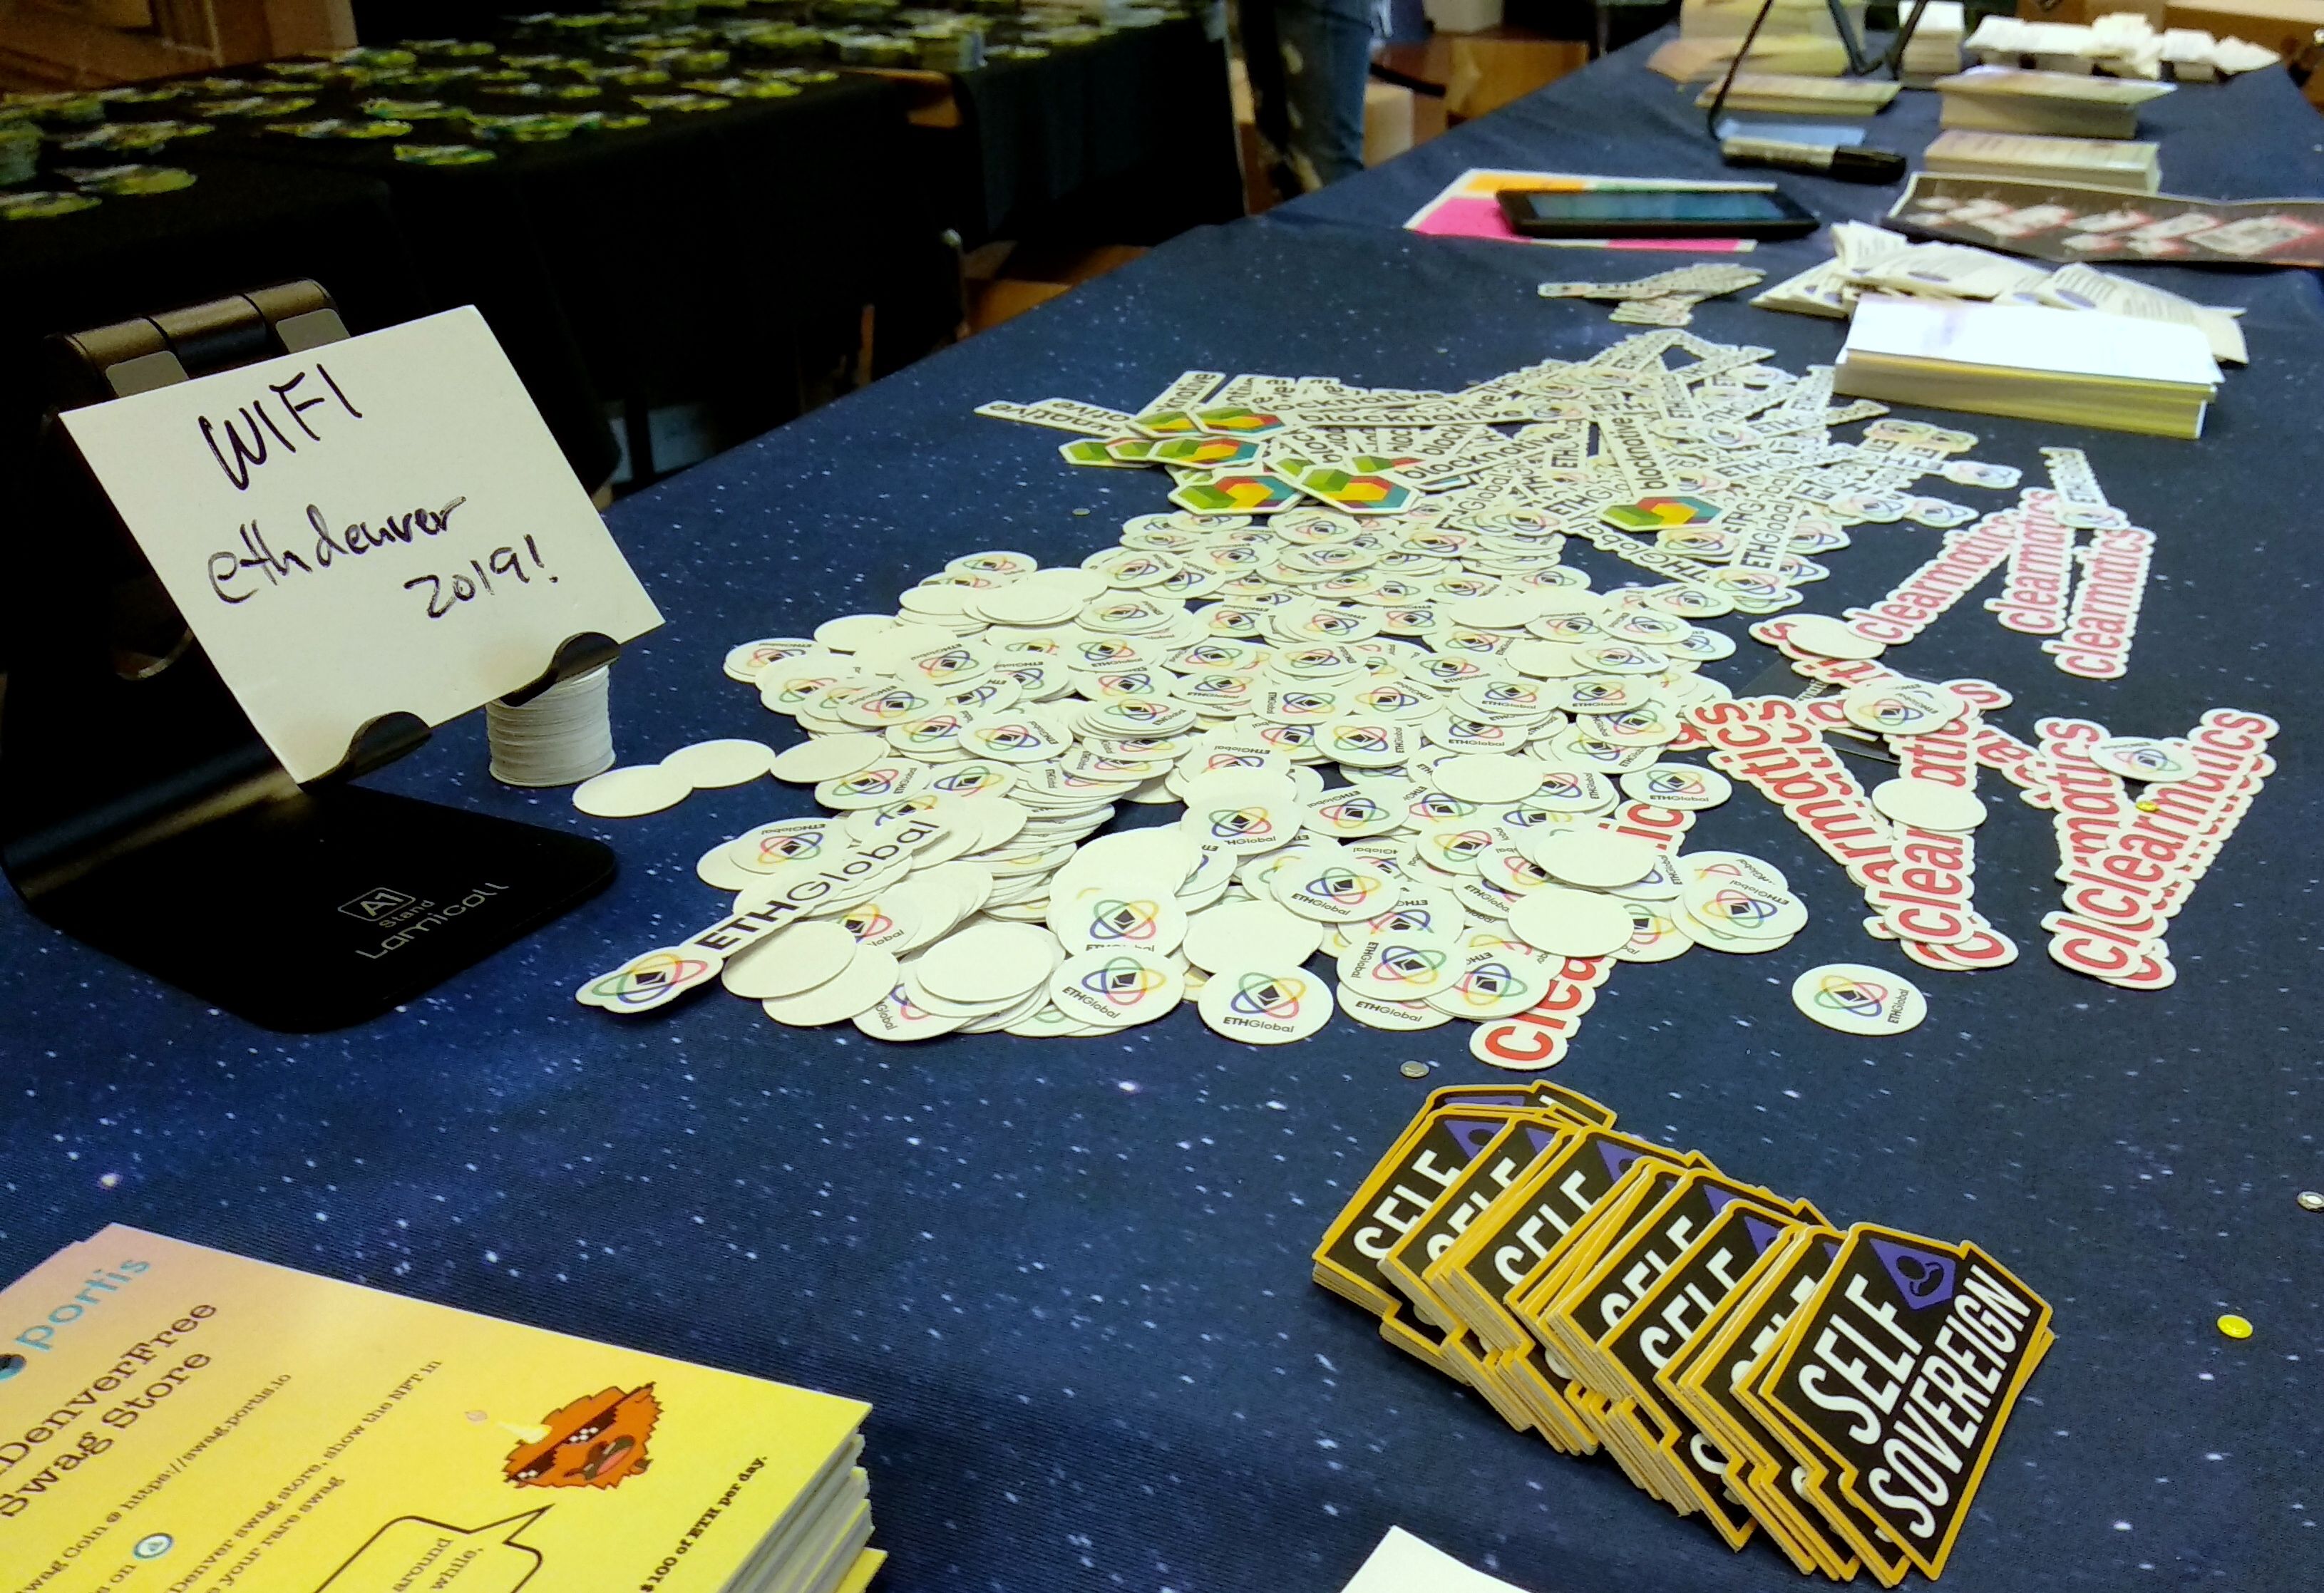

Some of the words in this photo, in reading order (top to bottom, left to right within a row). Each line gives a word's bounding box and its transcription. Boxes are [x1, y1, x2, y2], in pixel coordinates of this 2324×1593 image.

[198, 364, 363, 490] WIFI
[1394, 431, 1568, 480] blocknative
[1610, 417, 1668, 491] blocknative
[1569, 521, 1708, 583] THGlobal
[1741, 502, 1794, 569] ETHGlobal
[403, 534, 560, 619] 2019!
[1481, 700, 1536, 710] ETHGlobal
[1214, 746, 1271, 755] ETHGlobal
[1394, 726, 1405, 753] ETHGlobal
[894, 767, 918, 795] ETHGlobal
[1307, 790, 1361, 808] ETHGlobal
[761, 823, 826, 835] ETHGlobal
[694, 821, 940, 950] ETHGlobal
[1291, 892, 1351, 916] ETHGlobal
[1464, 884, 1510, 913] ETHGloba
[1729, 880, 1790, 905] ETHGlobal
[379, 899, 436, 928] Stand
[1351, 941, 1379, 979] ETHGlobal
[1061, 986, 1122, 1019] ETHGlobal
[1223, 1016, 1295, 1033] ETHGlobal
[1355, 1001, 1423, 1023] ETHGlobal
[1886, 987, 1910, 1025] ETHGlobal
[14, 1259, 151, 1353] portis
[1798, 1272, 1923, 1445] SELF
[0, 1304, 217, 1476] DenverFree
[101, 1353, 212, 1429] Store
[1868, 1264, 2032, 1539] SOVEREIGN
[233, 1500, 283, 1540] swag
[277, 1460, 329, 1500] store,
[323, 1425, 366, 1460] show
[362, 1401, 394, 1424] the
[388, 1372, 425, 1402] NFT
[419, 1359, 443, 1376] in
[218, 1545, 264, 1587] your
[261, 1513, 302, 1548] rare
[298, 1475, 346, 1514] swag
[686, 1507, 722, 1540] ETH
[716, 1481, 743, 1507] per
[109, 1563, 138, 1585] on
[392, 1537, 454, 1593] around
[430, 1546, 485, 1592] while,
